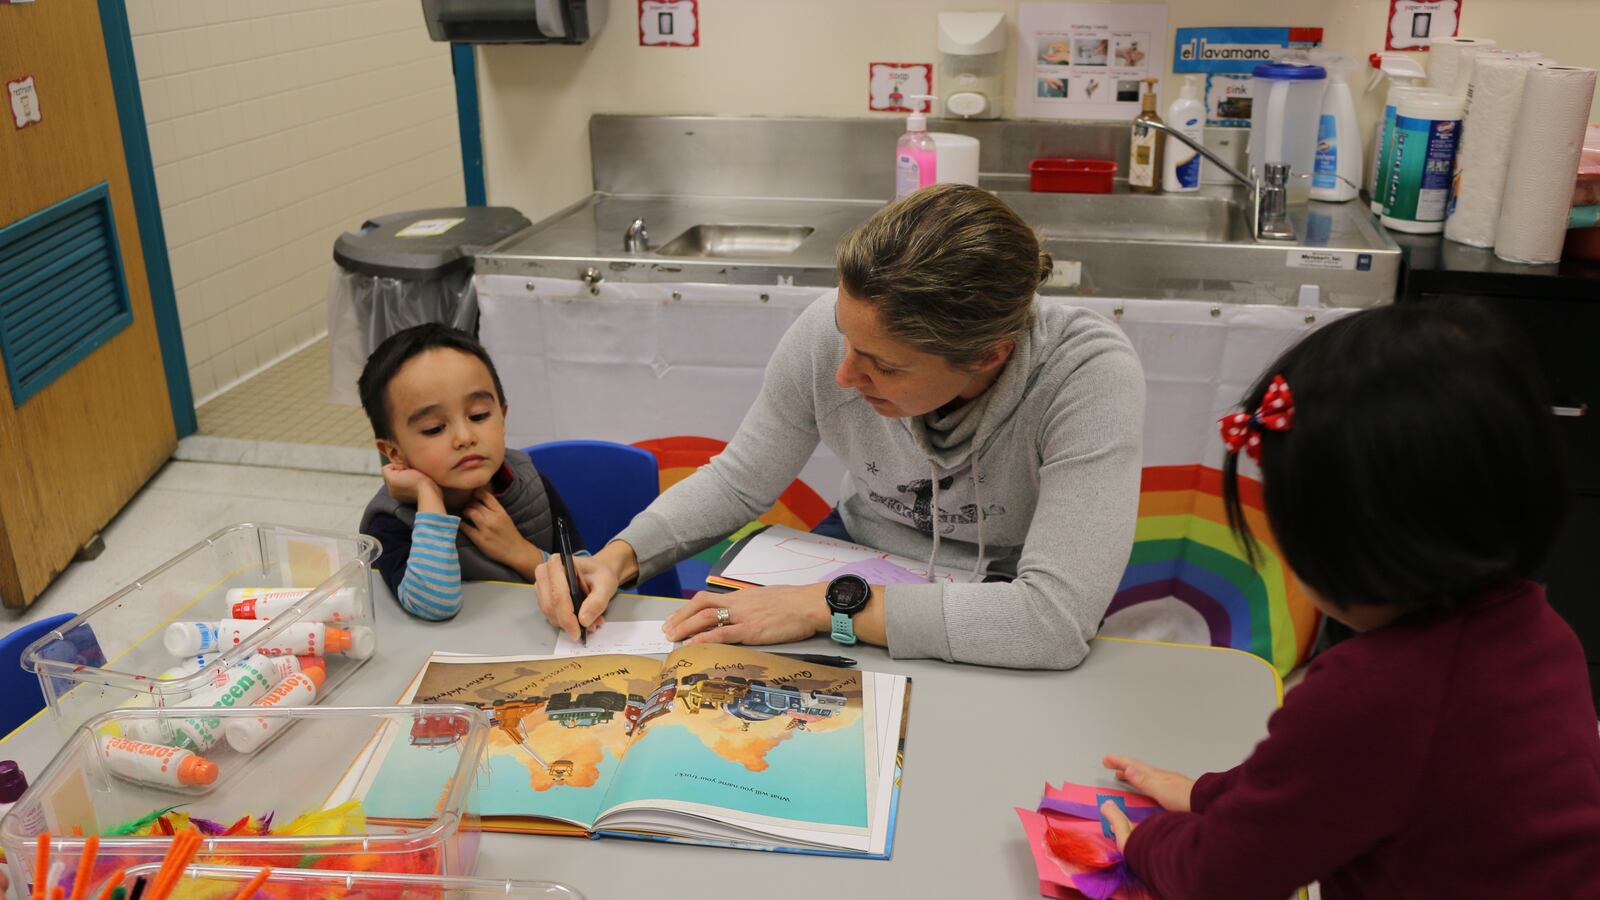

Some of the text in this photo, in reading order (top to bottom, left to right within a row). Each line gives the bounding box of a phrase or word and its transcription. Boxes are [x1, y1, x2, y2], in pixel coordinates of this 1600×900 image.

[1182, 40, 1270, 59] el lavamano
[889, 73, 909, 82] soap
[1226, 83, 1248, 95] sink
[715, 662, 744, 672] Dusty
[110, 738, 169, 758] orange
[755, 789, 769, 797] will
[770, 793, 790, 802] What
